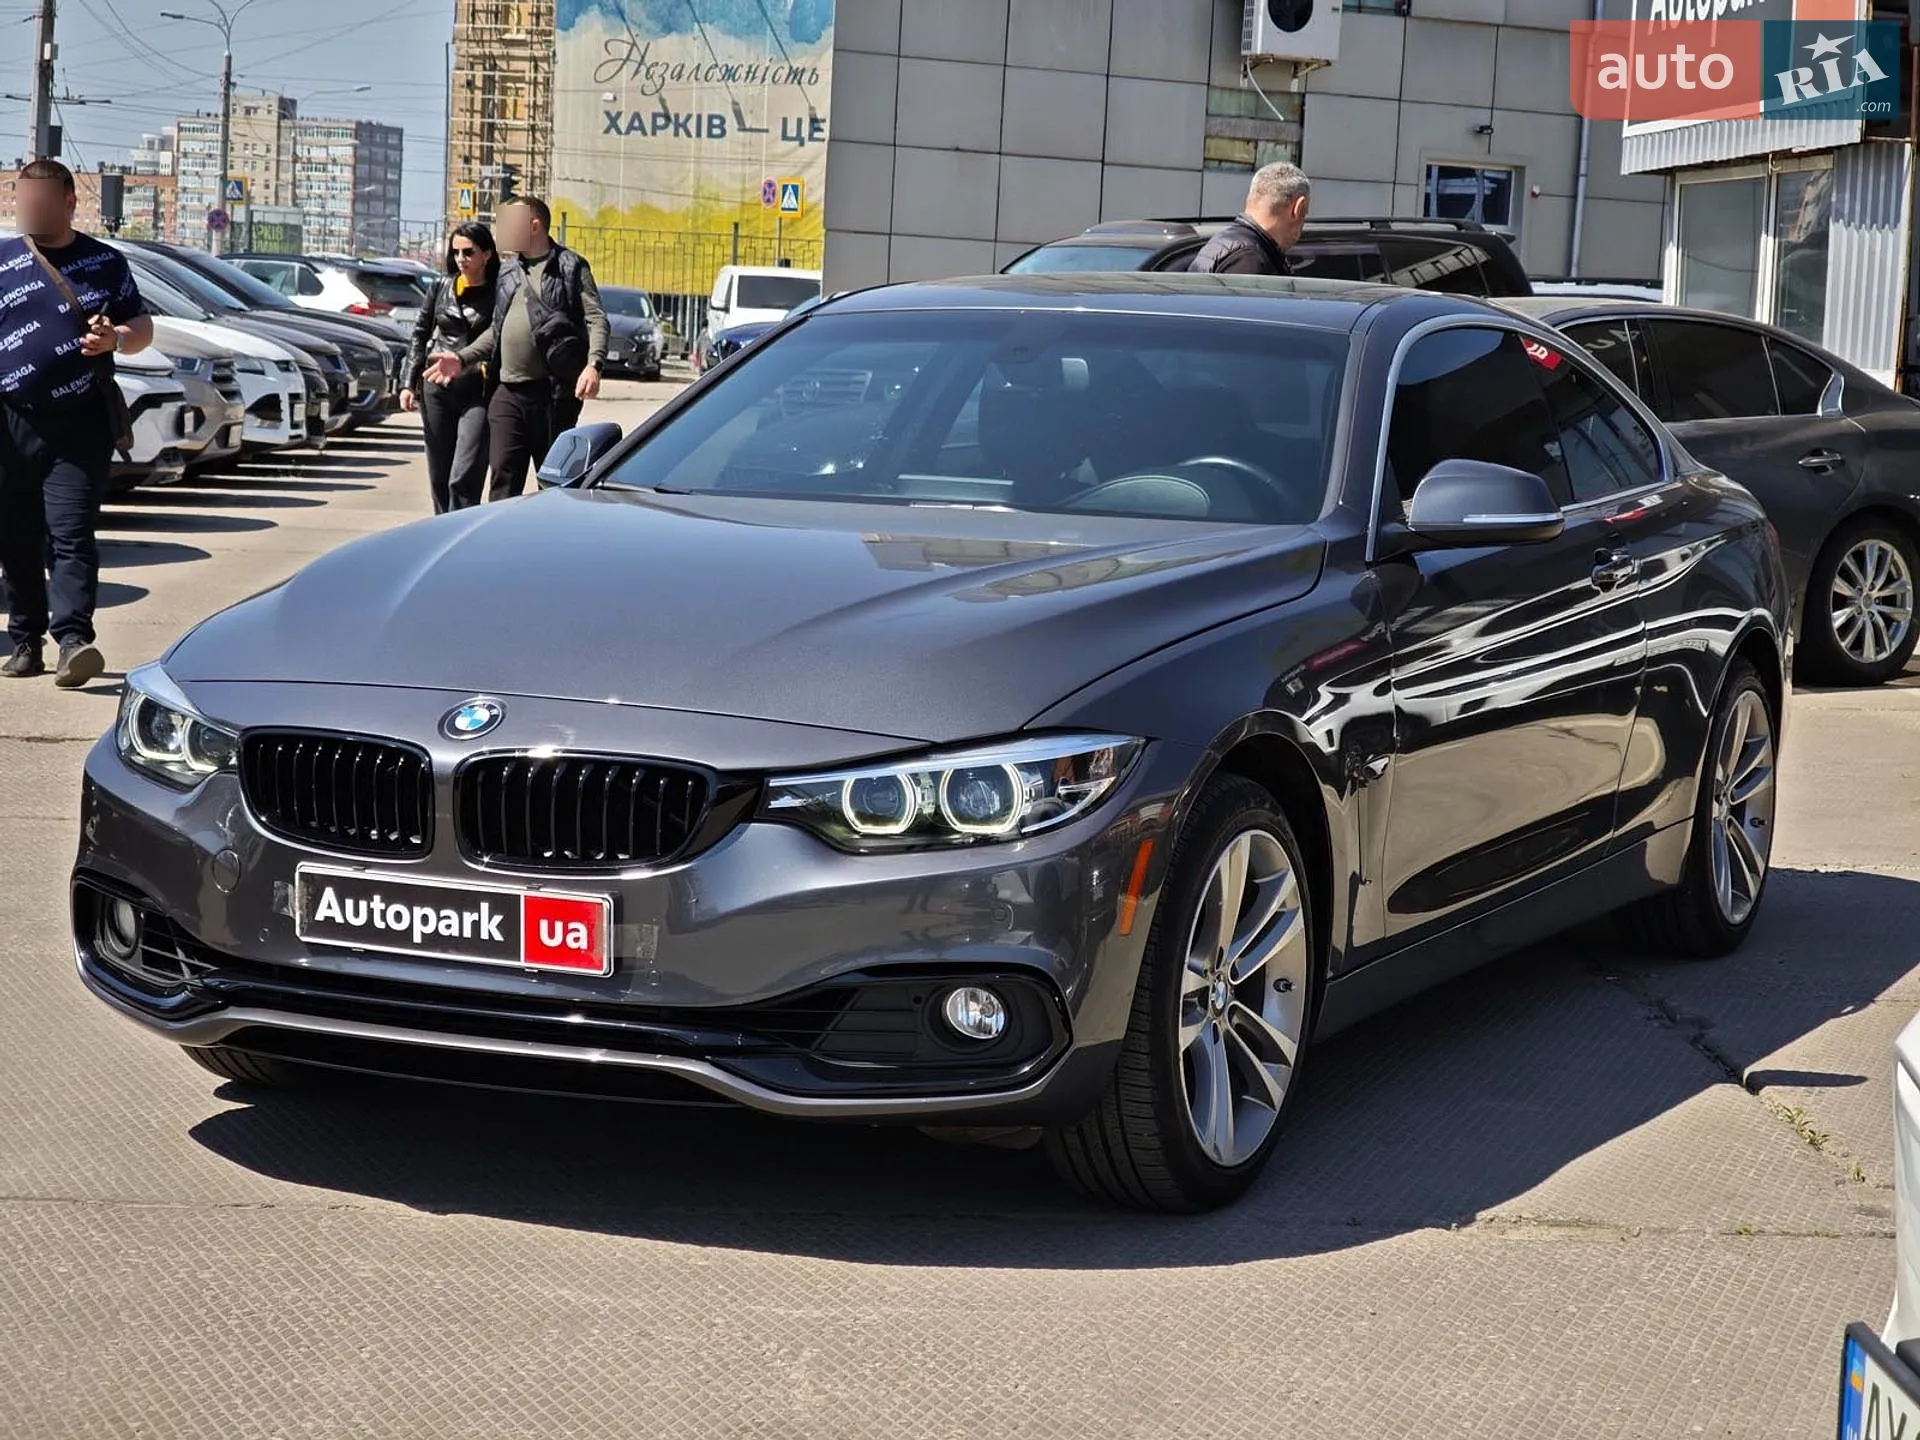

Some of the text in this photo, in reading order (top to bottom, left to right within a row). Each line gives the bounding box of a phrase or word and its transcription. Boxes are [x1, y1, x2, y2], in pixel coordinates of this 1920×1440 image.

[594, 37, 820, 96] Незалежність
[603, 110, 727, 139] ХАРКІВ
[314, 887, 589, 951] Autopark ua
